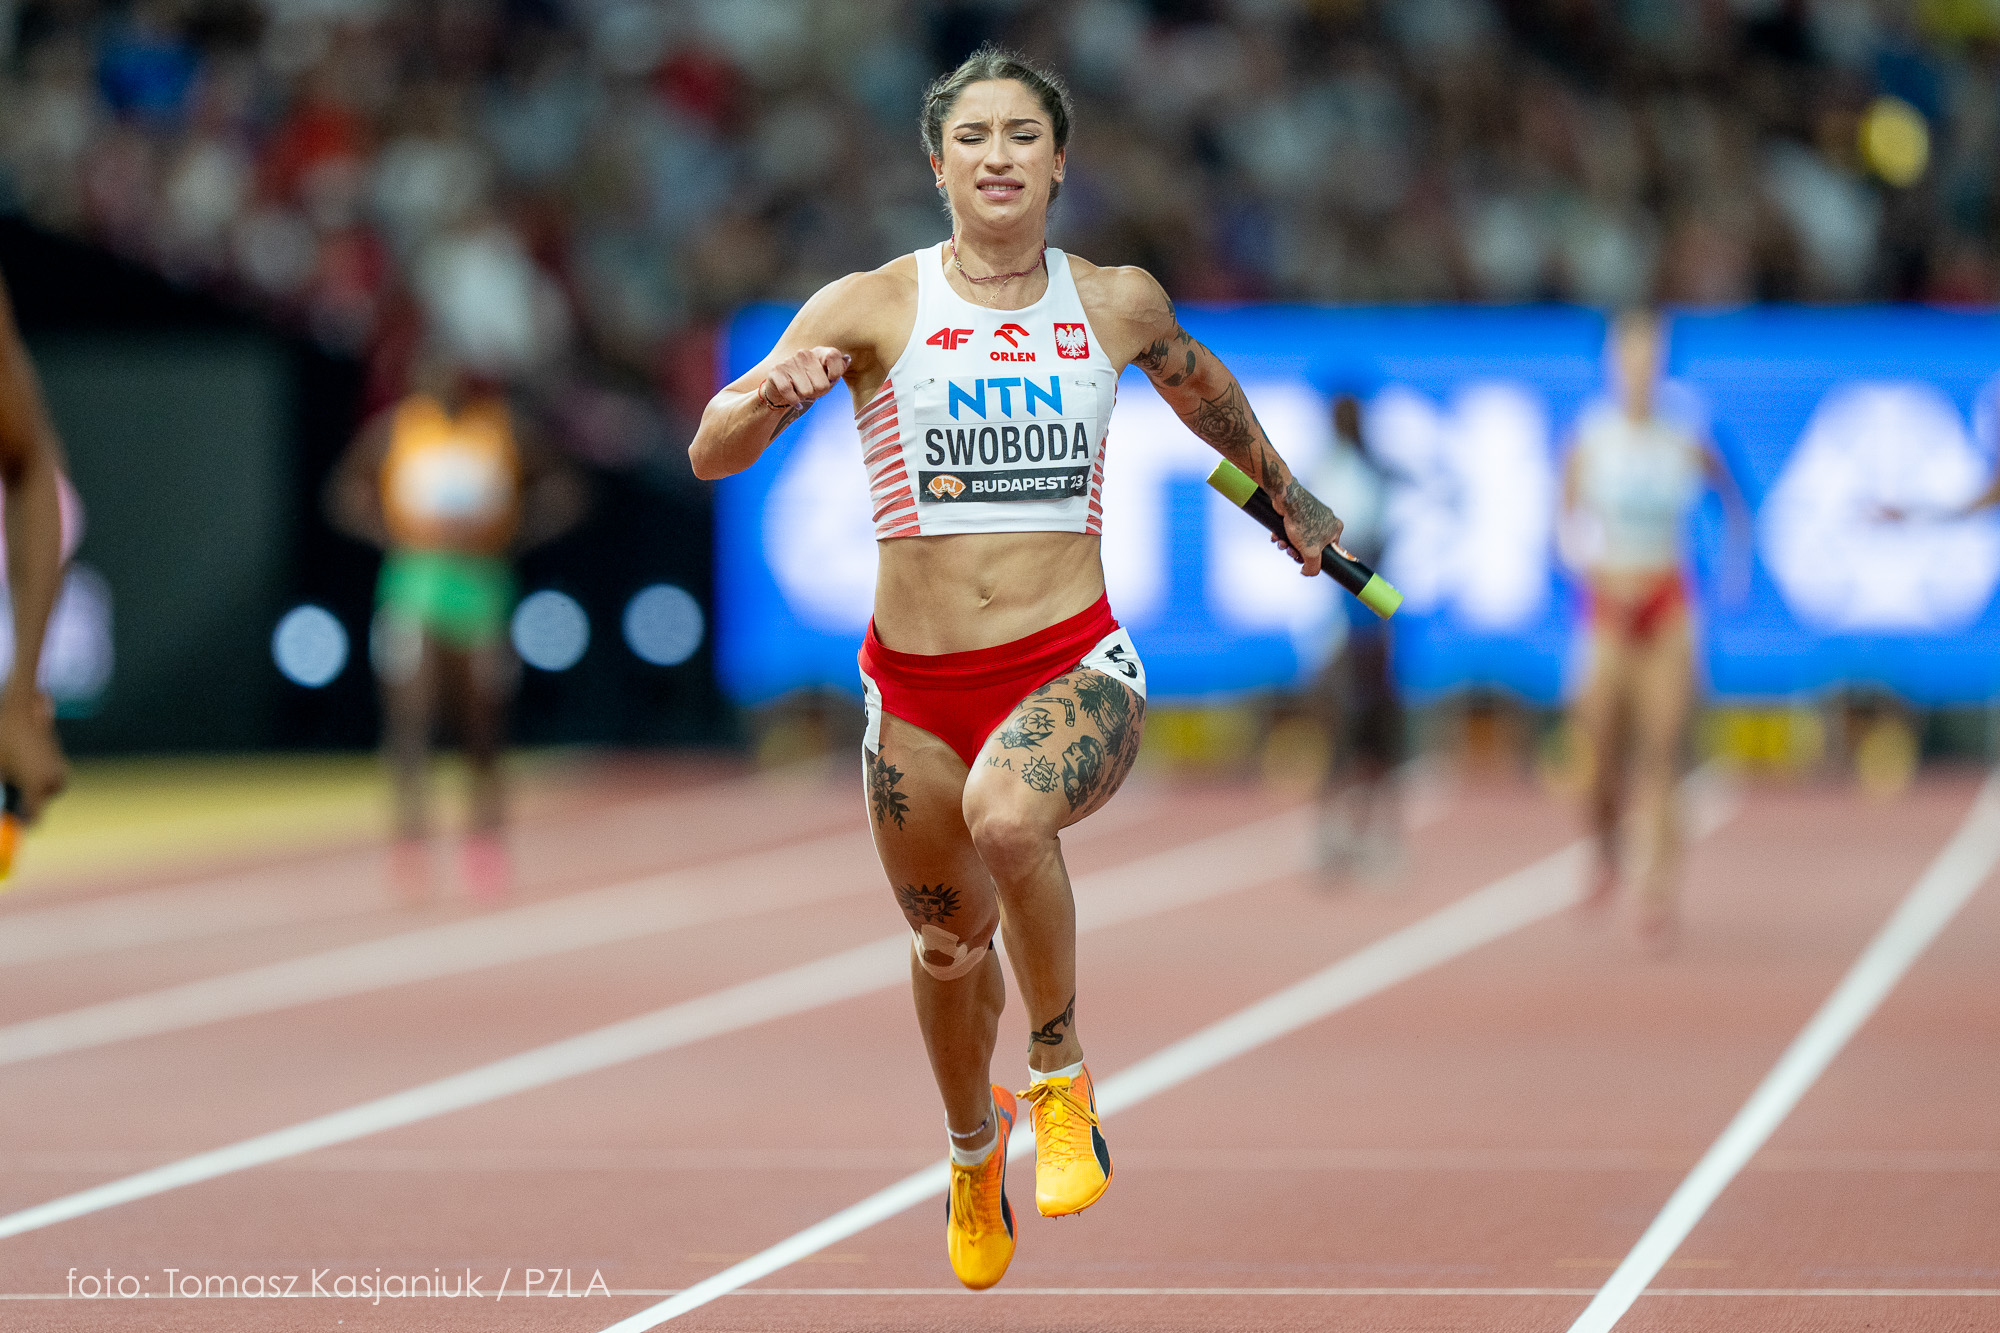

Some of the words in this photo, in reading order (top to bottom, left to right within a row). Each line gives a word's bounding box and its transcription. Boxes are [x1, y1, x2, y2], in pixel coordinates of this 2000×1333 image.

[926, 327, 974, 350] 4F
[989, 351, 1036, 362] ORLEN
[948, 375, 1063, 421] NTN
[925, 422, 1089, 466] SWOBODA
[971, 476, 1069, 493] BUDAPEST
[1104, 644, 1138, 679] 5
